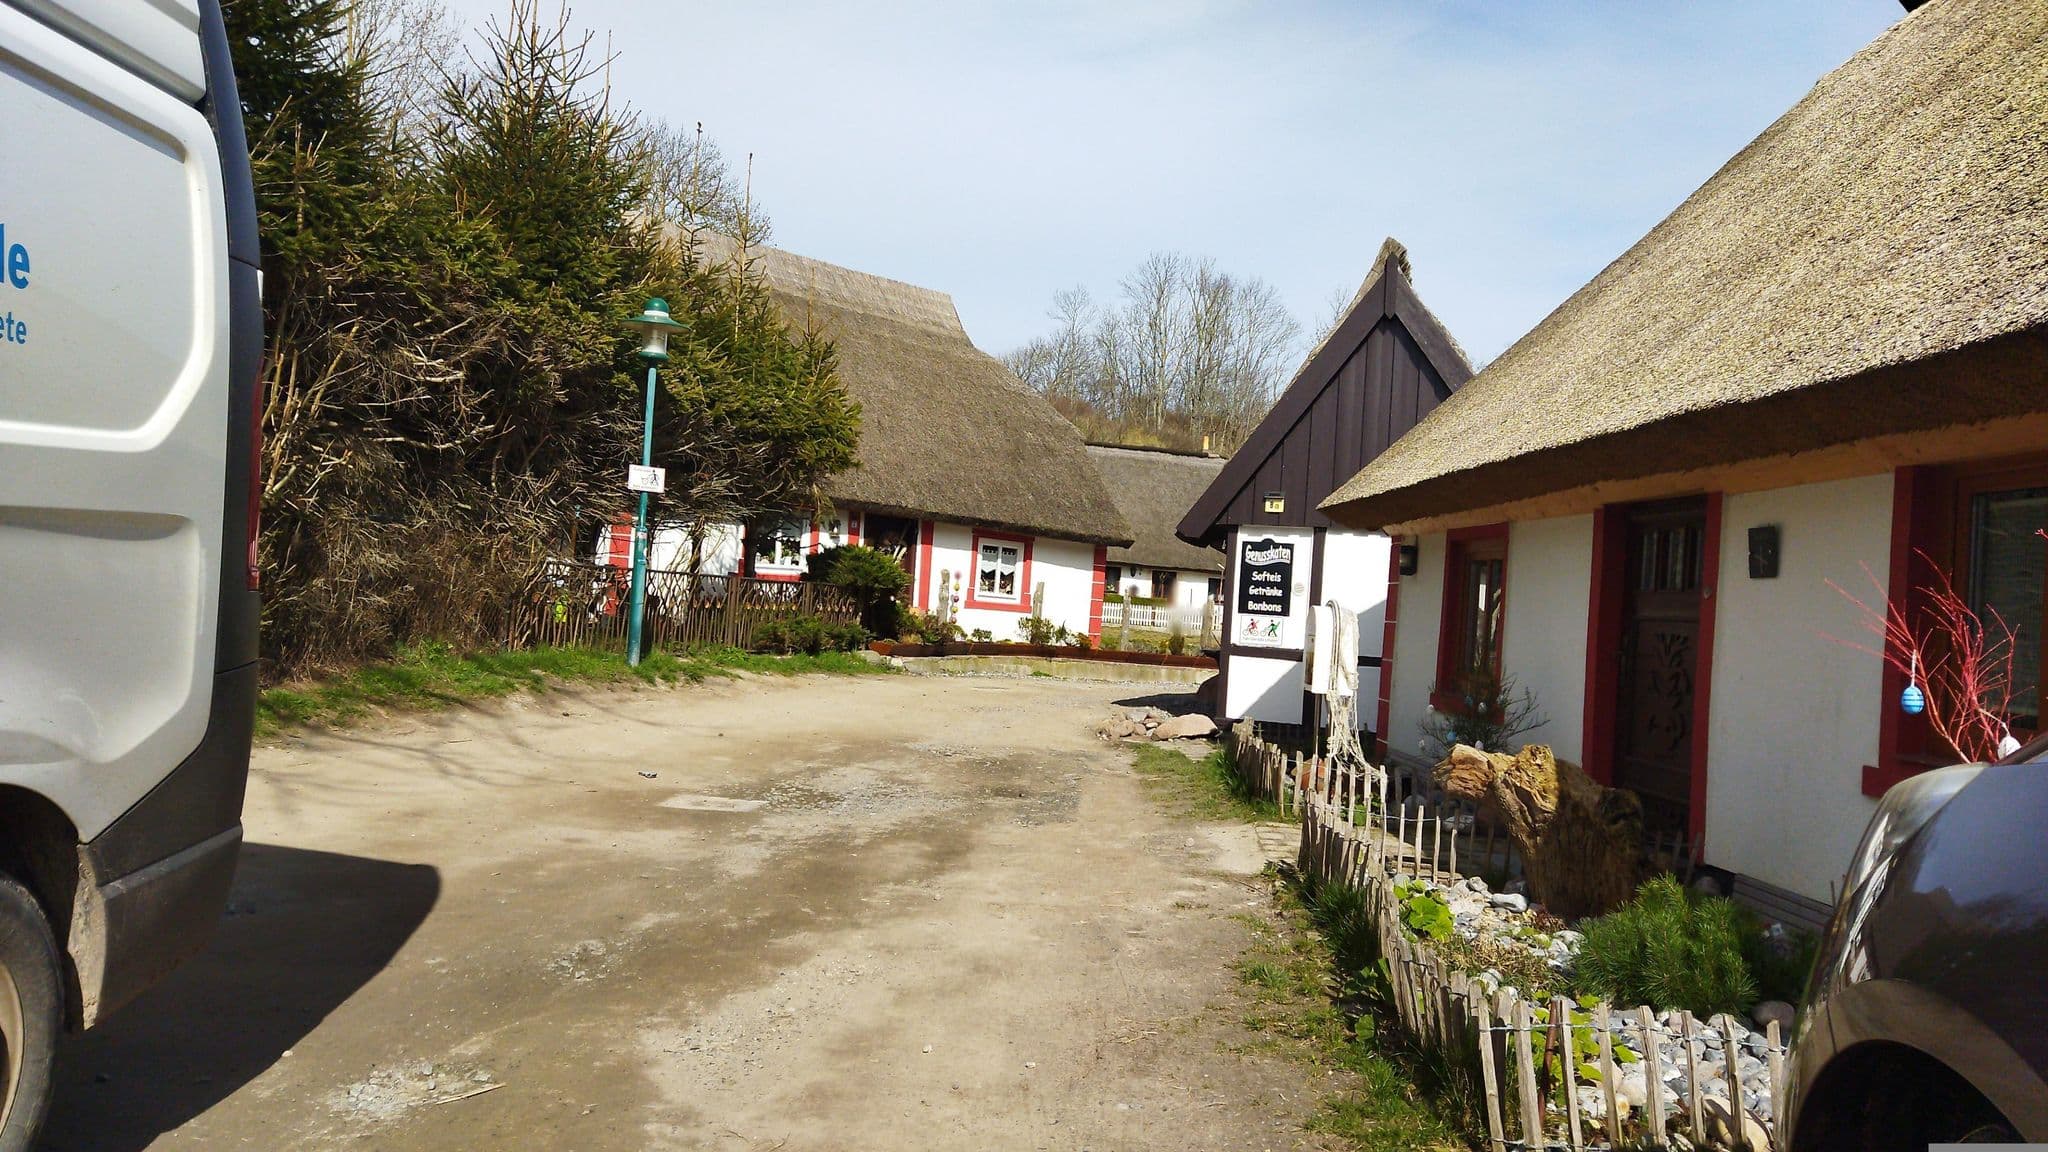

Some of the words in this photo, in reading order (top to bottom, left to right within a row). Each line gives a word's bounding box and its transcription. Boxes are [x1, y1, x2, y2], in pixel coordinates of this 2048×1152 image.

[1251, 571, 1282, 582] Softeis
[1248, 585, 1283, 597] Getränke
[1247, 601, 1282, 612] Bonbons
